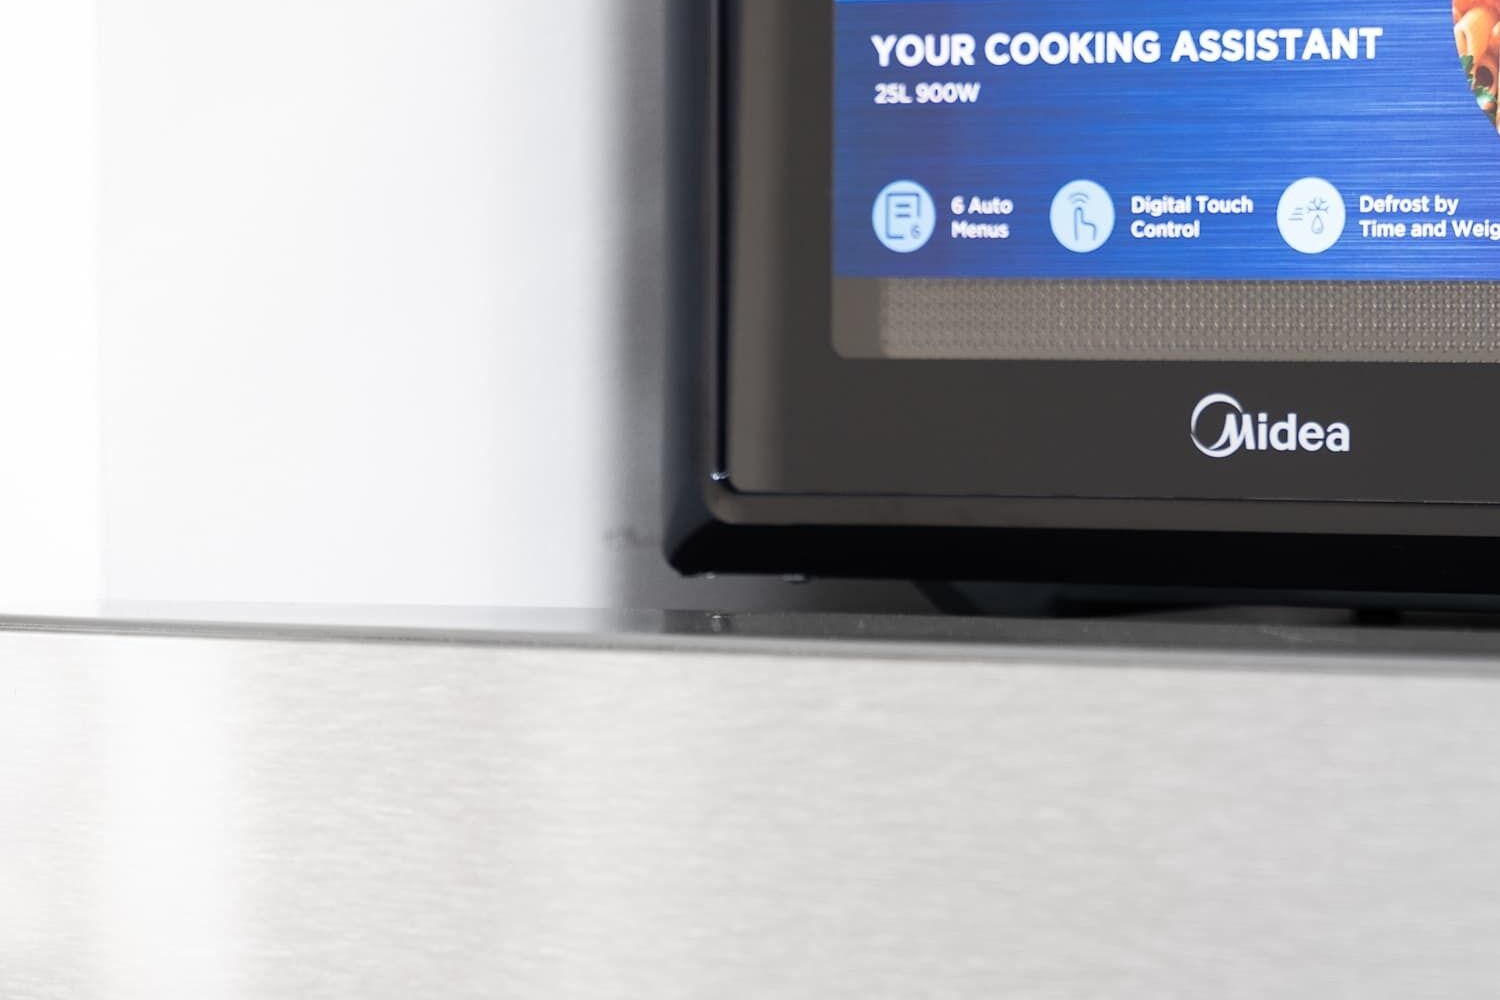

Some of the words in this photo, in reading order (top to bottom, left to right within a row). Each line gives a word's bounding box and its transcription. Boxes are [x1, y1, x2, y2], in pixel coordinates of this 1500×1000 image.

[871, 34, 976, 67] YOUR
[984, 31, 1162, 66] COOKING
[1170, 27, 1384, 63] ASSISTANT
[874, 84, 912, 104] 25L
[915, 82, 980, 104] 900W
[951, 196, 964, 214] 6
[968, 197, 1013, 214] Auto
[1131, 194, 1192, 218] Digital
[1195, 194, 1254, 216] Touch
[1359, 195, 1429, 213] Defrost
[1435, 195, 1459, 216] by
[951, 222, 1010, 238] Menus
[1130, 218, 1201, 240] Control
[1359, 220, 1408, 237] Time
[1411, 220, 1446, 237] and
[1190, 392, 1350, 458] Midea
